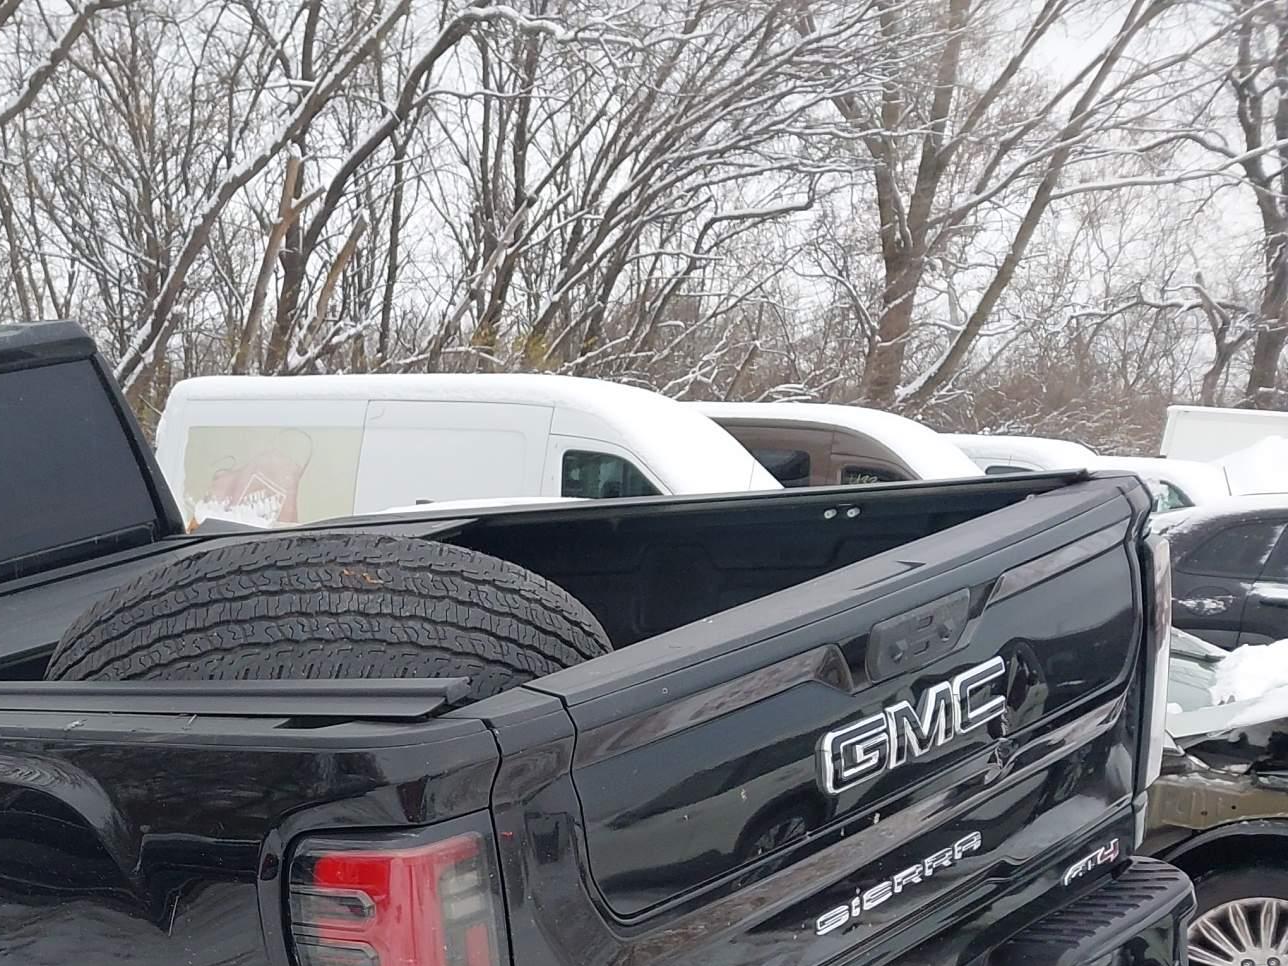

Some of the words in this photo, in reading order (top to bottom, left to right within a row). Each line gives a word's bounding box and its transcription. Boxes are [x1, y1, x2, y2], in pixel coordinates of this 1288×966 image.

[823, 656, 1006, 794] GMC
[816, 831, 981, 936] SIERRA
[1064, 838, 1119, 886] AT4
